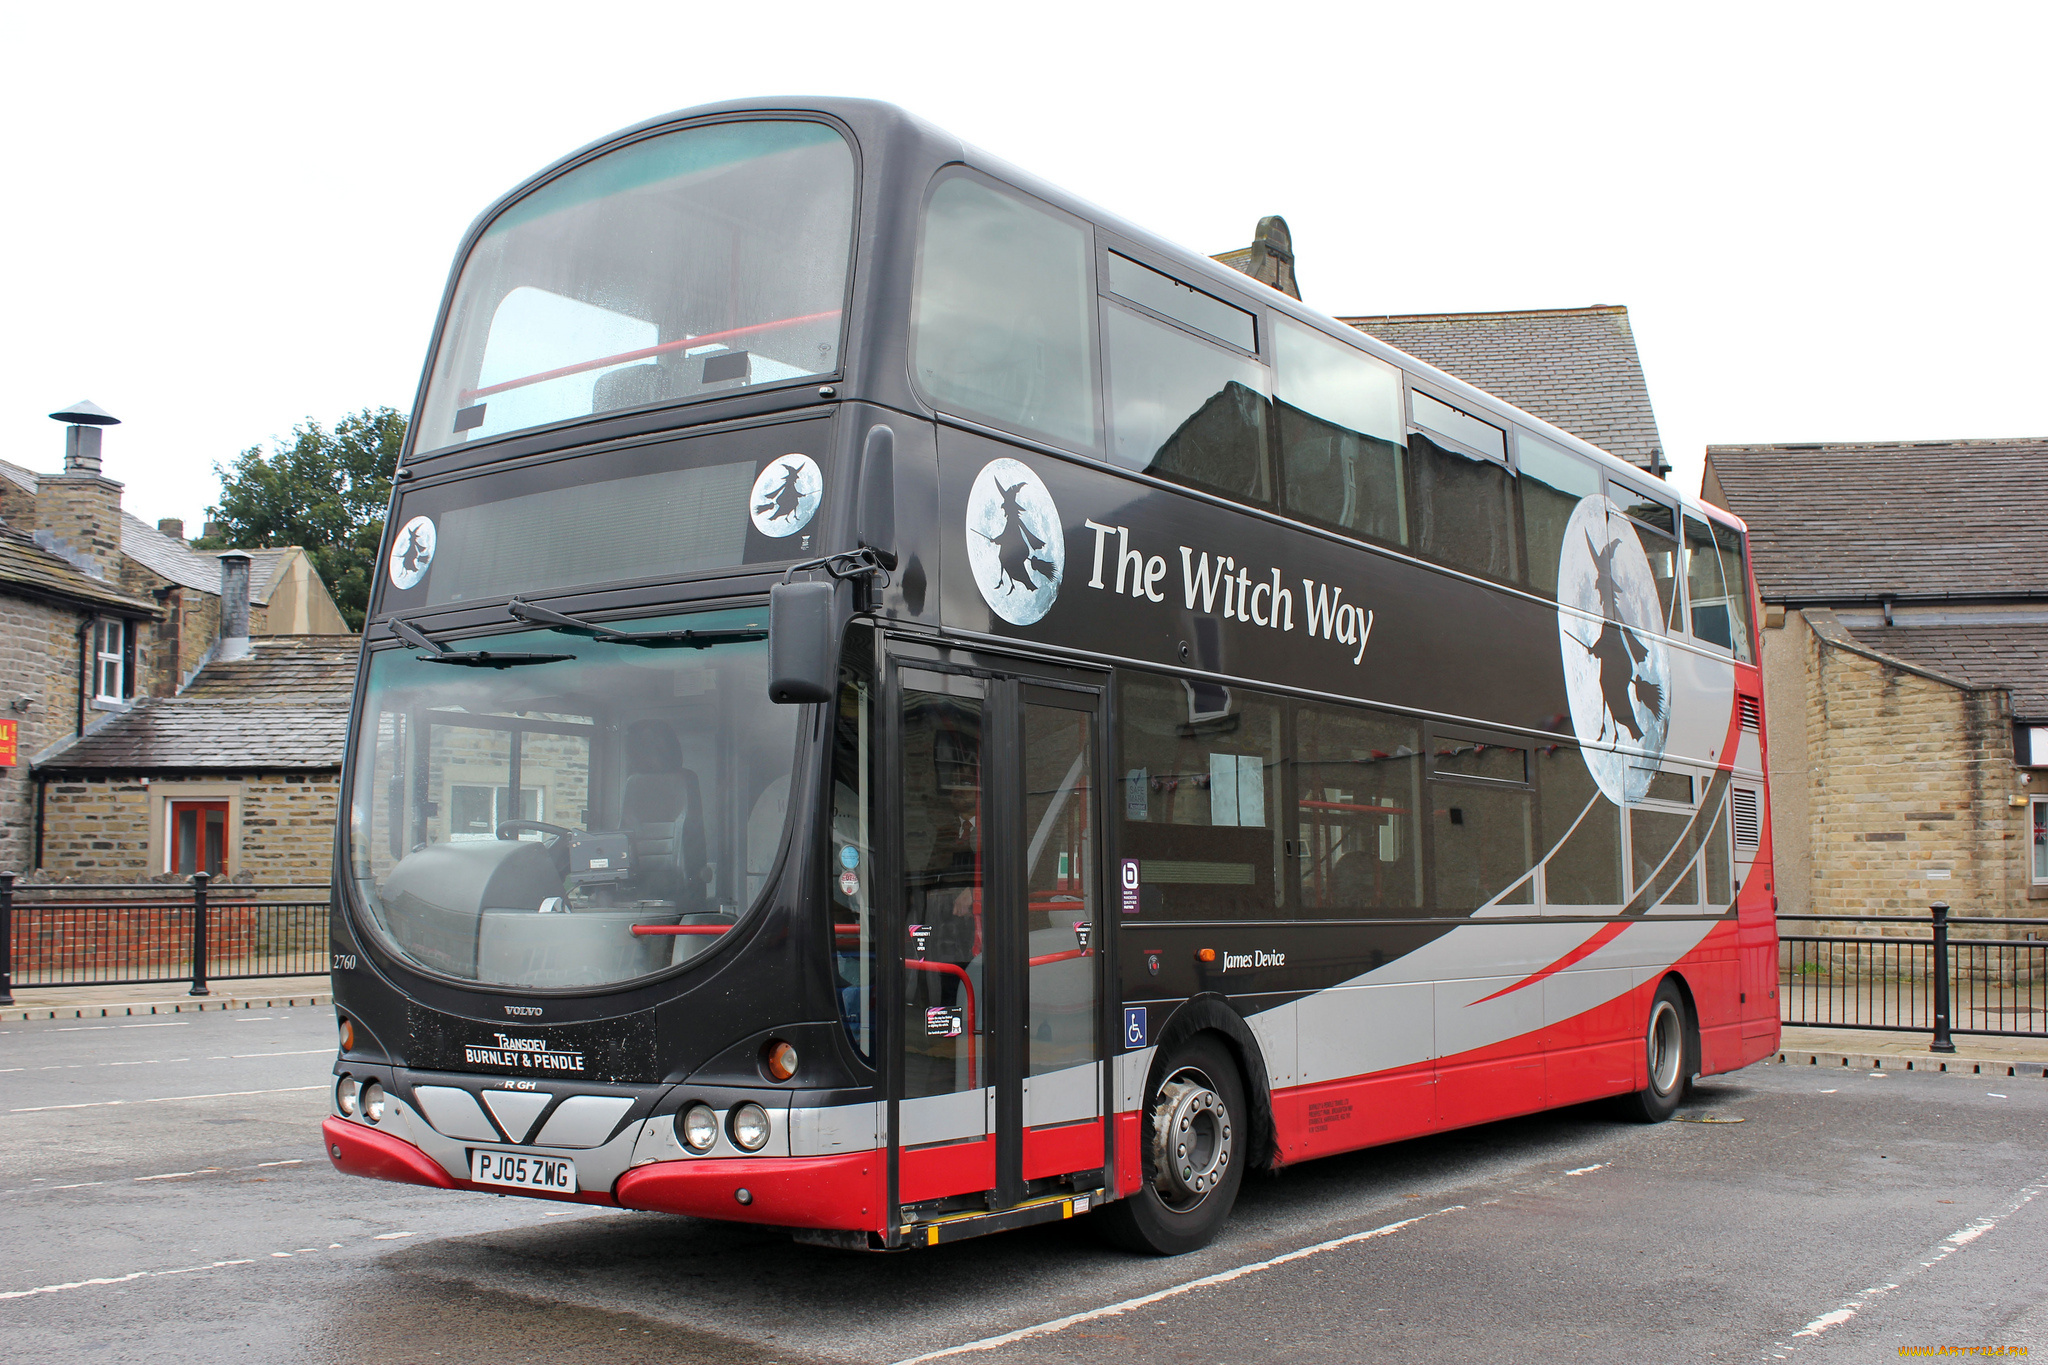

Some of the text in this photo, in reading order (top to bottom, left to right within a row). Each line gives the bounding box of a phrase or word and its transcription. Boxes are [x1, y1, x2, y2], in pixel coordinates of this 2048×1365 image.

[1085, 518, 1374, 666] The Witch Way
[333, 954, 357, 970] 2760
[1222, 948, 1286, 973] James Device
[504, 1005, 543, 1017] VOLVO
[465, 1048, 585, 1071] BURNLEY & PENDLE
[480, 1154, 568, 1187] PJ05 ZWG
